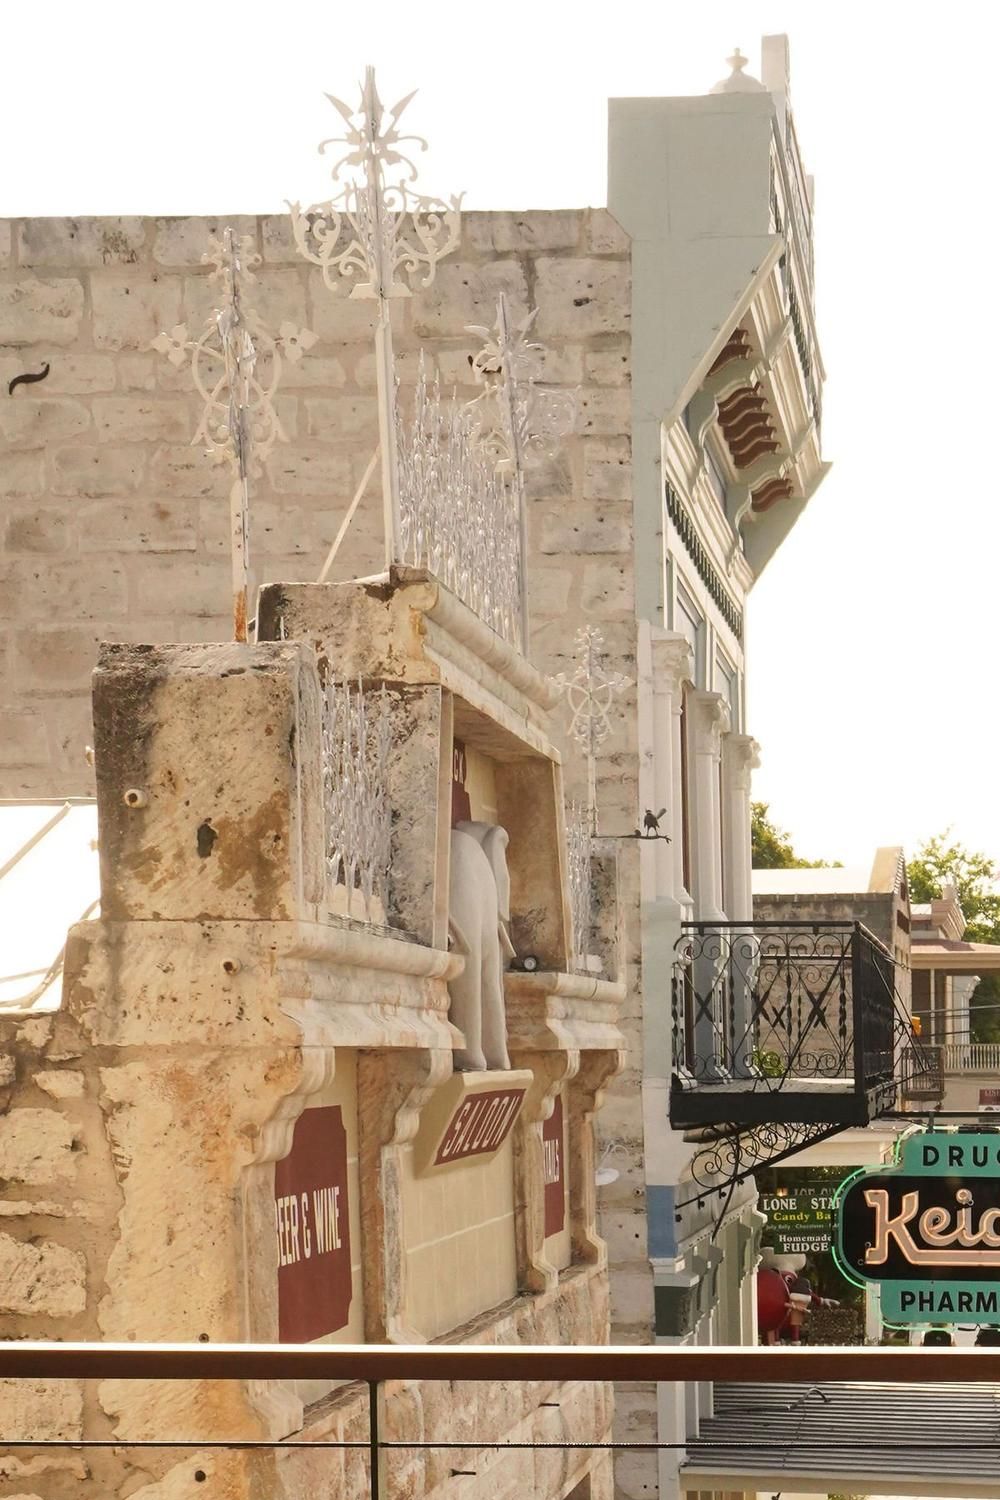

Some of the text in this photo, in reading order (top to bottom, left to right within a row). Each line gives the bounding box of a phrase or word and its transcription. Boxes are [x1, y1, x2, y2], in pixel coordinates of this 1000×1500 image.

[441, 1095, 520, 1158] SALOON
[763, 1198, 798, 1211] LONE
[313, 1185, 342, 1256] WINE
[773, 1212, 810, 1222] Candy
[783, 1242, 829, 1253] FUDGE
